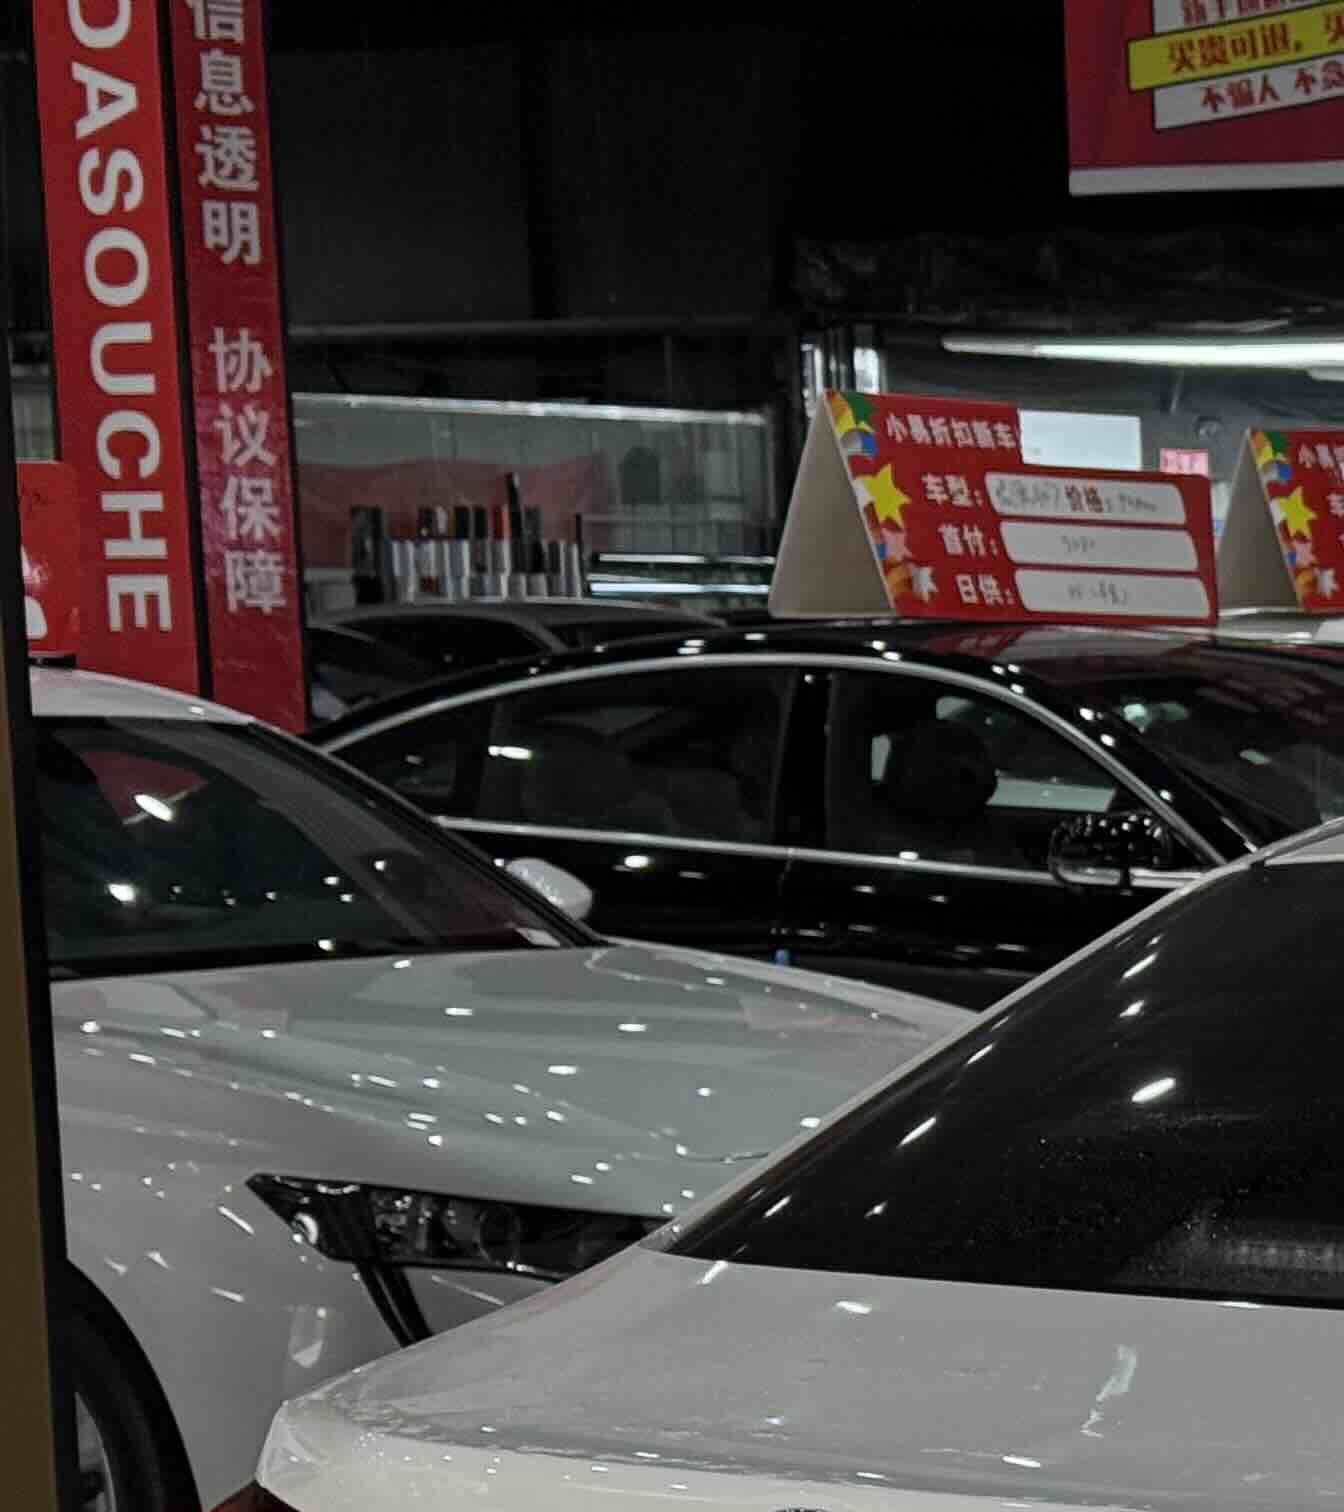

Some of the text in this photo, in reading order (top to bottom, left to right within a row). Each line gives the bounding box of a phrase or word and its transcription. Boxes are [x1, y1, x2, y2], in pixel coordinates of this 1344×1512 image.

[69, 0, 172, 632] DASOUCHE
[188, 0, 288, 615] 信息透明 协议保障
